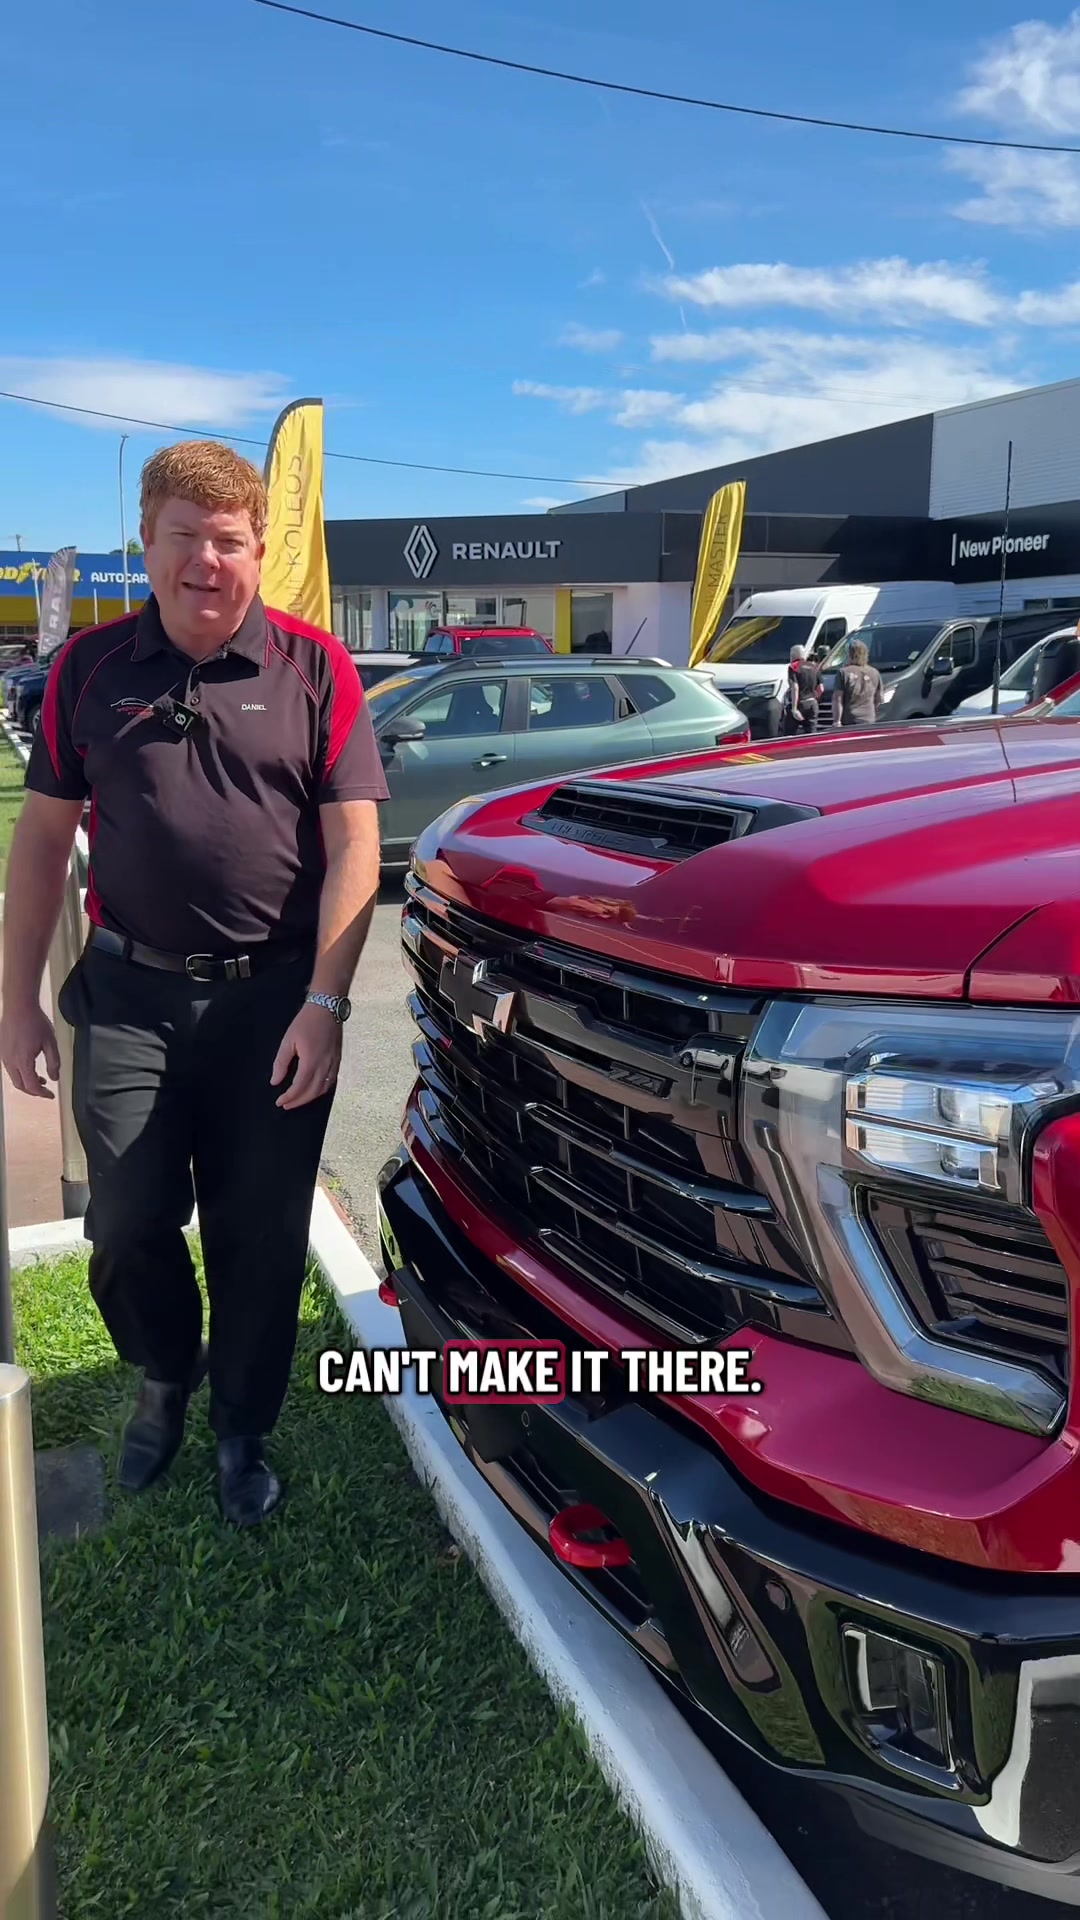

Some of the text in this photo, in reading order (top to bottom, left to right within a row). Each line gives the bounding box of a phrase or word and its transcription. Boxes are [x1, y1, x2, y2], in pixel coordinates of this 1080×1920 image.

[284, 455, 303, 566] KOLEOS
[452, 541, 561, 560] RENAULT
[708, 513, 728, 587] MASTER
[959, 534, 1050, 558] New Pioneer
[241, 703, 267, 711] DANIEL
